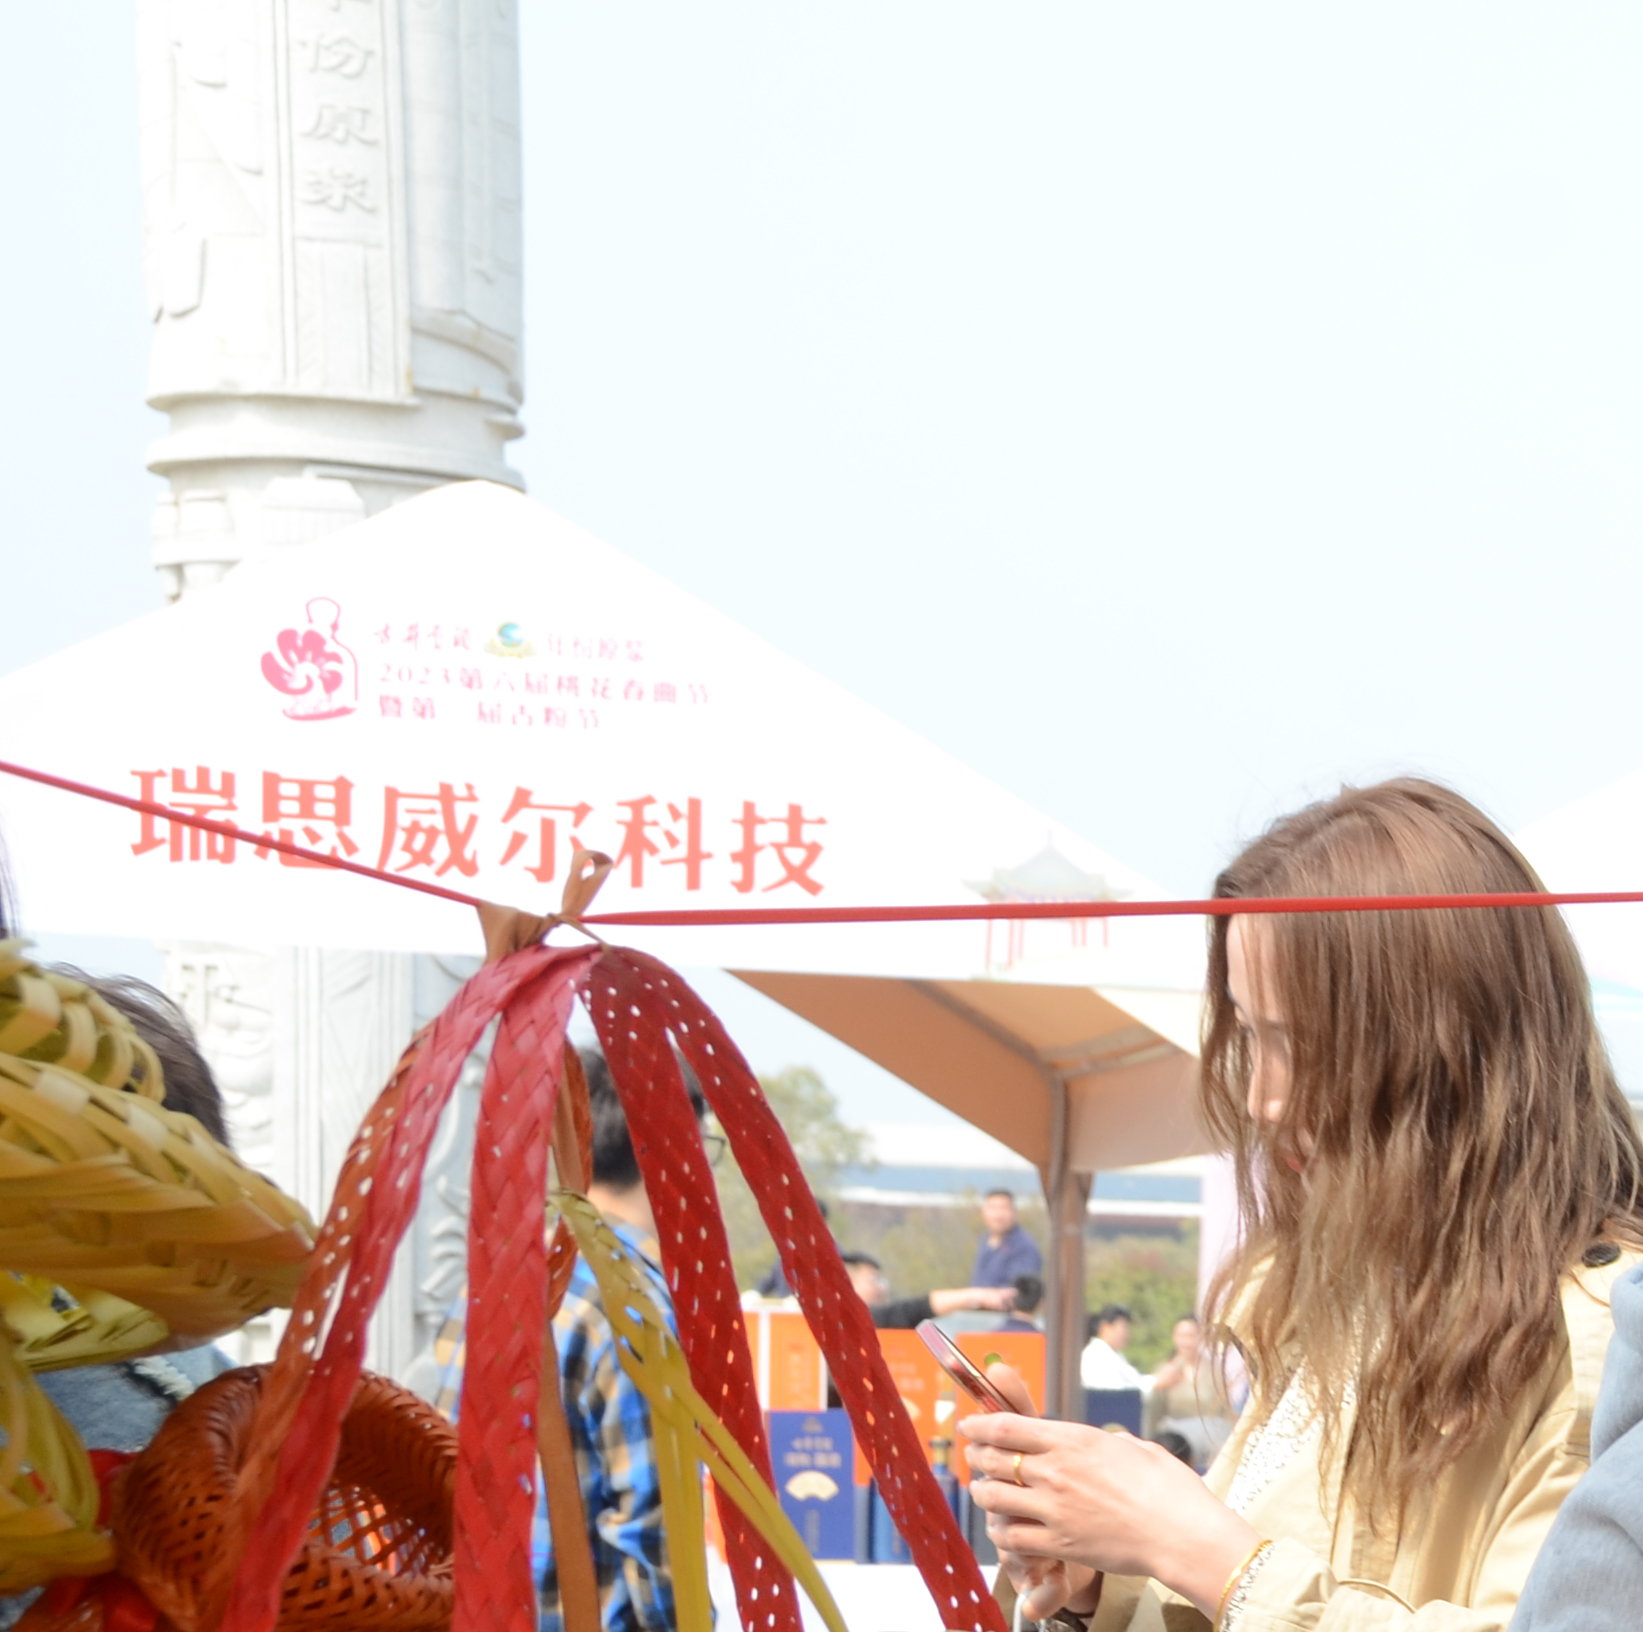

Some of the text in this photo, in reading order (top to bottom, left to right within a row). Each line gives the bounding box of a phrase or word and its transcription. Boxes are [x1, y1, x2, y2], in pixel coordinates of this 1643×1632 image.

[130, 765, 828, 897] 瑞思威尔科技
